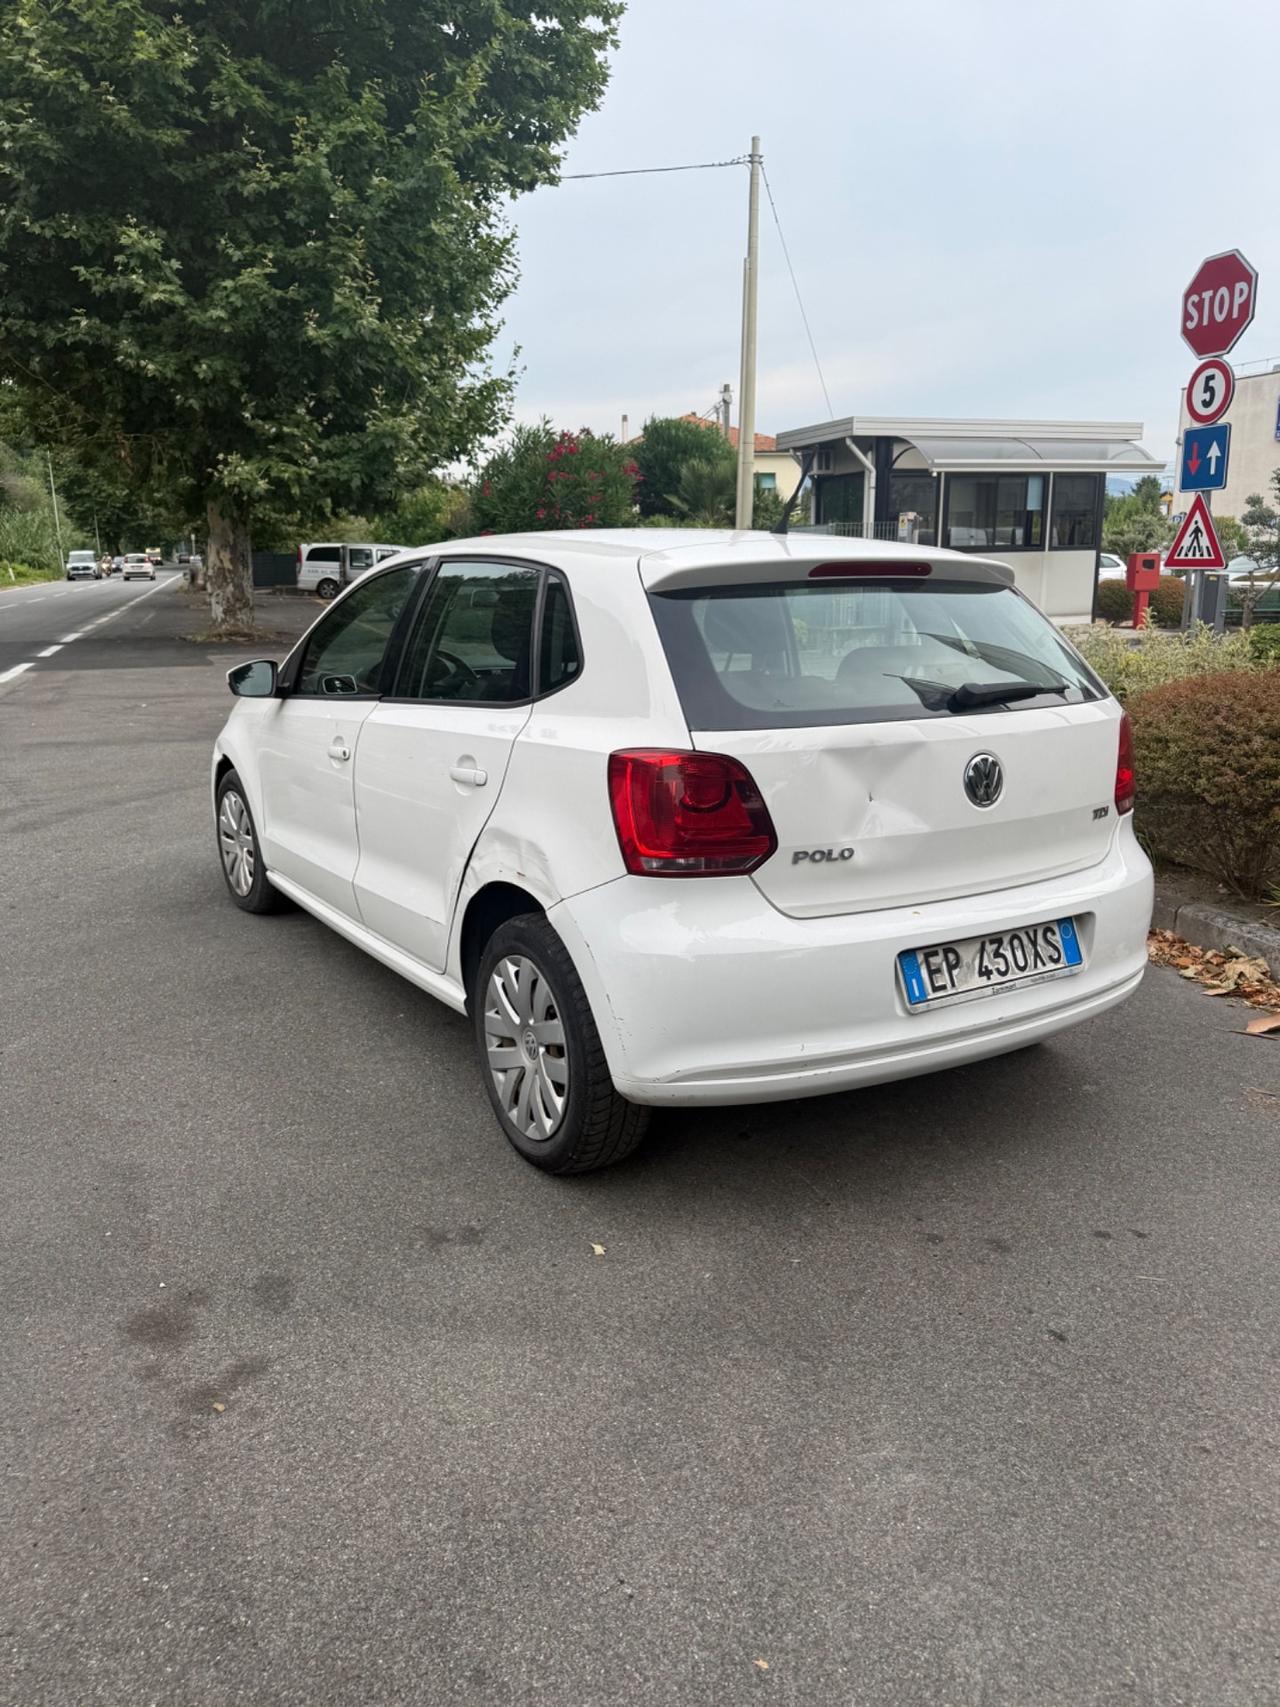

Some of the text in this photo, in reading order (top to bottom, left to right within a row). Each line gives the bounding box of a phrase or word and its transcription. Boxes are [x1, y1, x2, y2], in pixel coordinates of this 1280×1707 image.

[1185, 281, 1250, 330] STOP
[1201, 373, 1216, 409] 5
[791, 847, 855, 865] POLO
[923, 926, 1062, 994] EP 430XS
